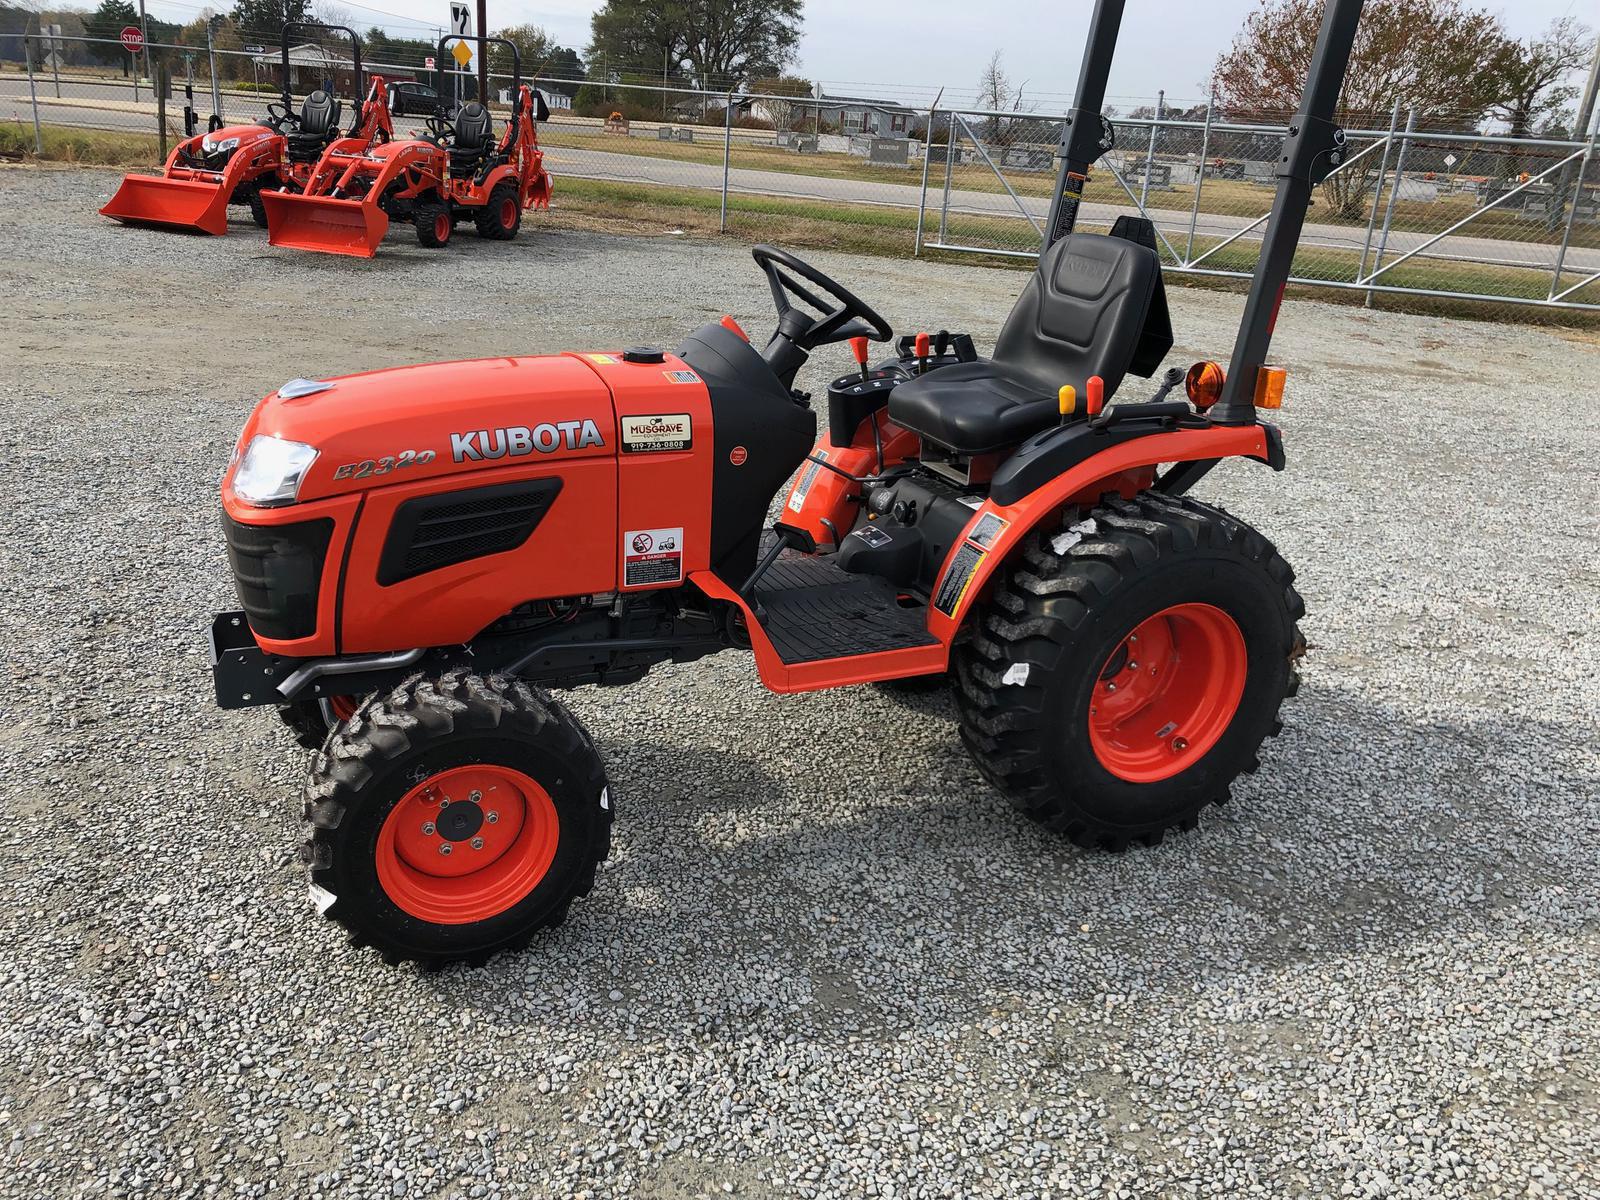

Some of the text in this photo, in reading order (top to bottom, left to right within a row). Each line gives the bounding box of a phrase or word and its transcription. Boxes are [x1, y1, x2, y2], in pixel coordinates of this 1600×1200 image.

[122, 34, 142, 43] STOP
[630, 423, 683, 434] MUSGRAVE
[450, 419, 605, 463] KUBOTA
[333, 449, 437, 481] B2320
